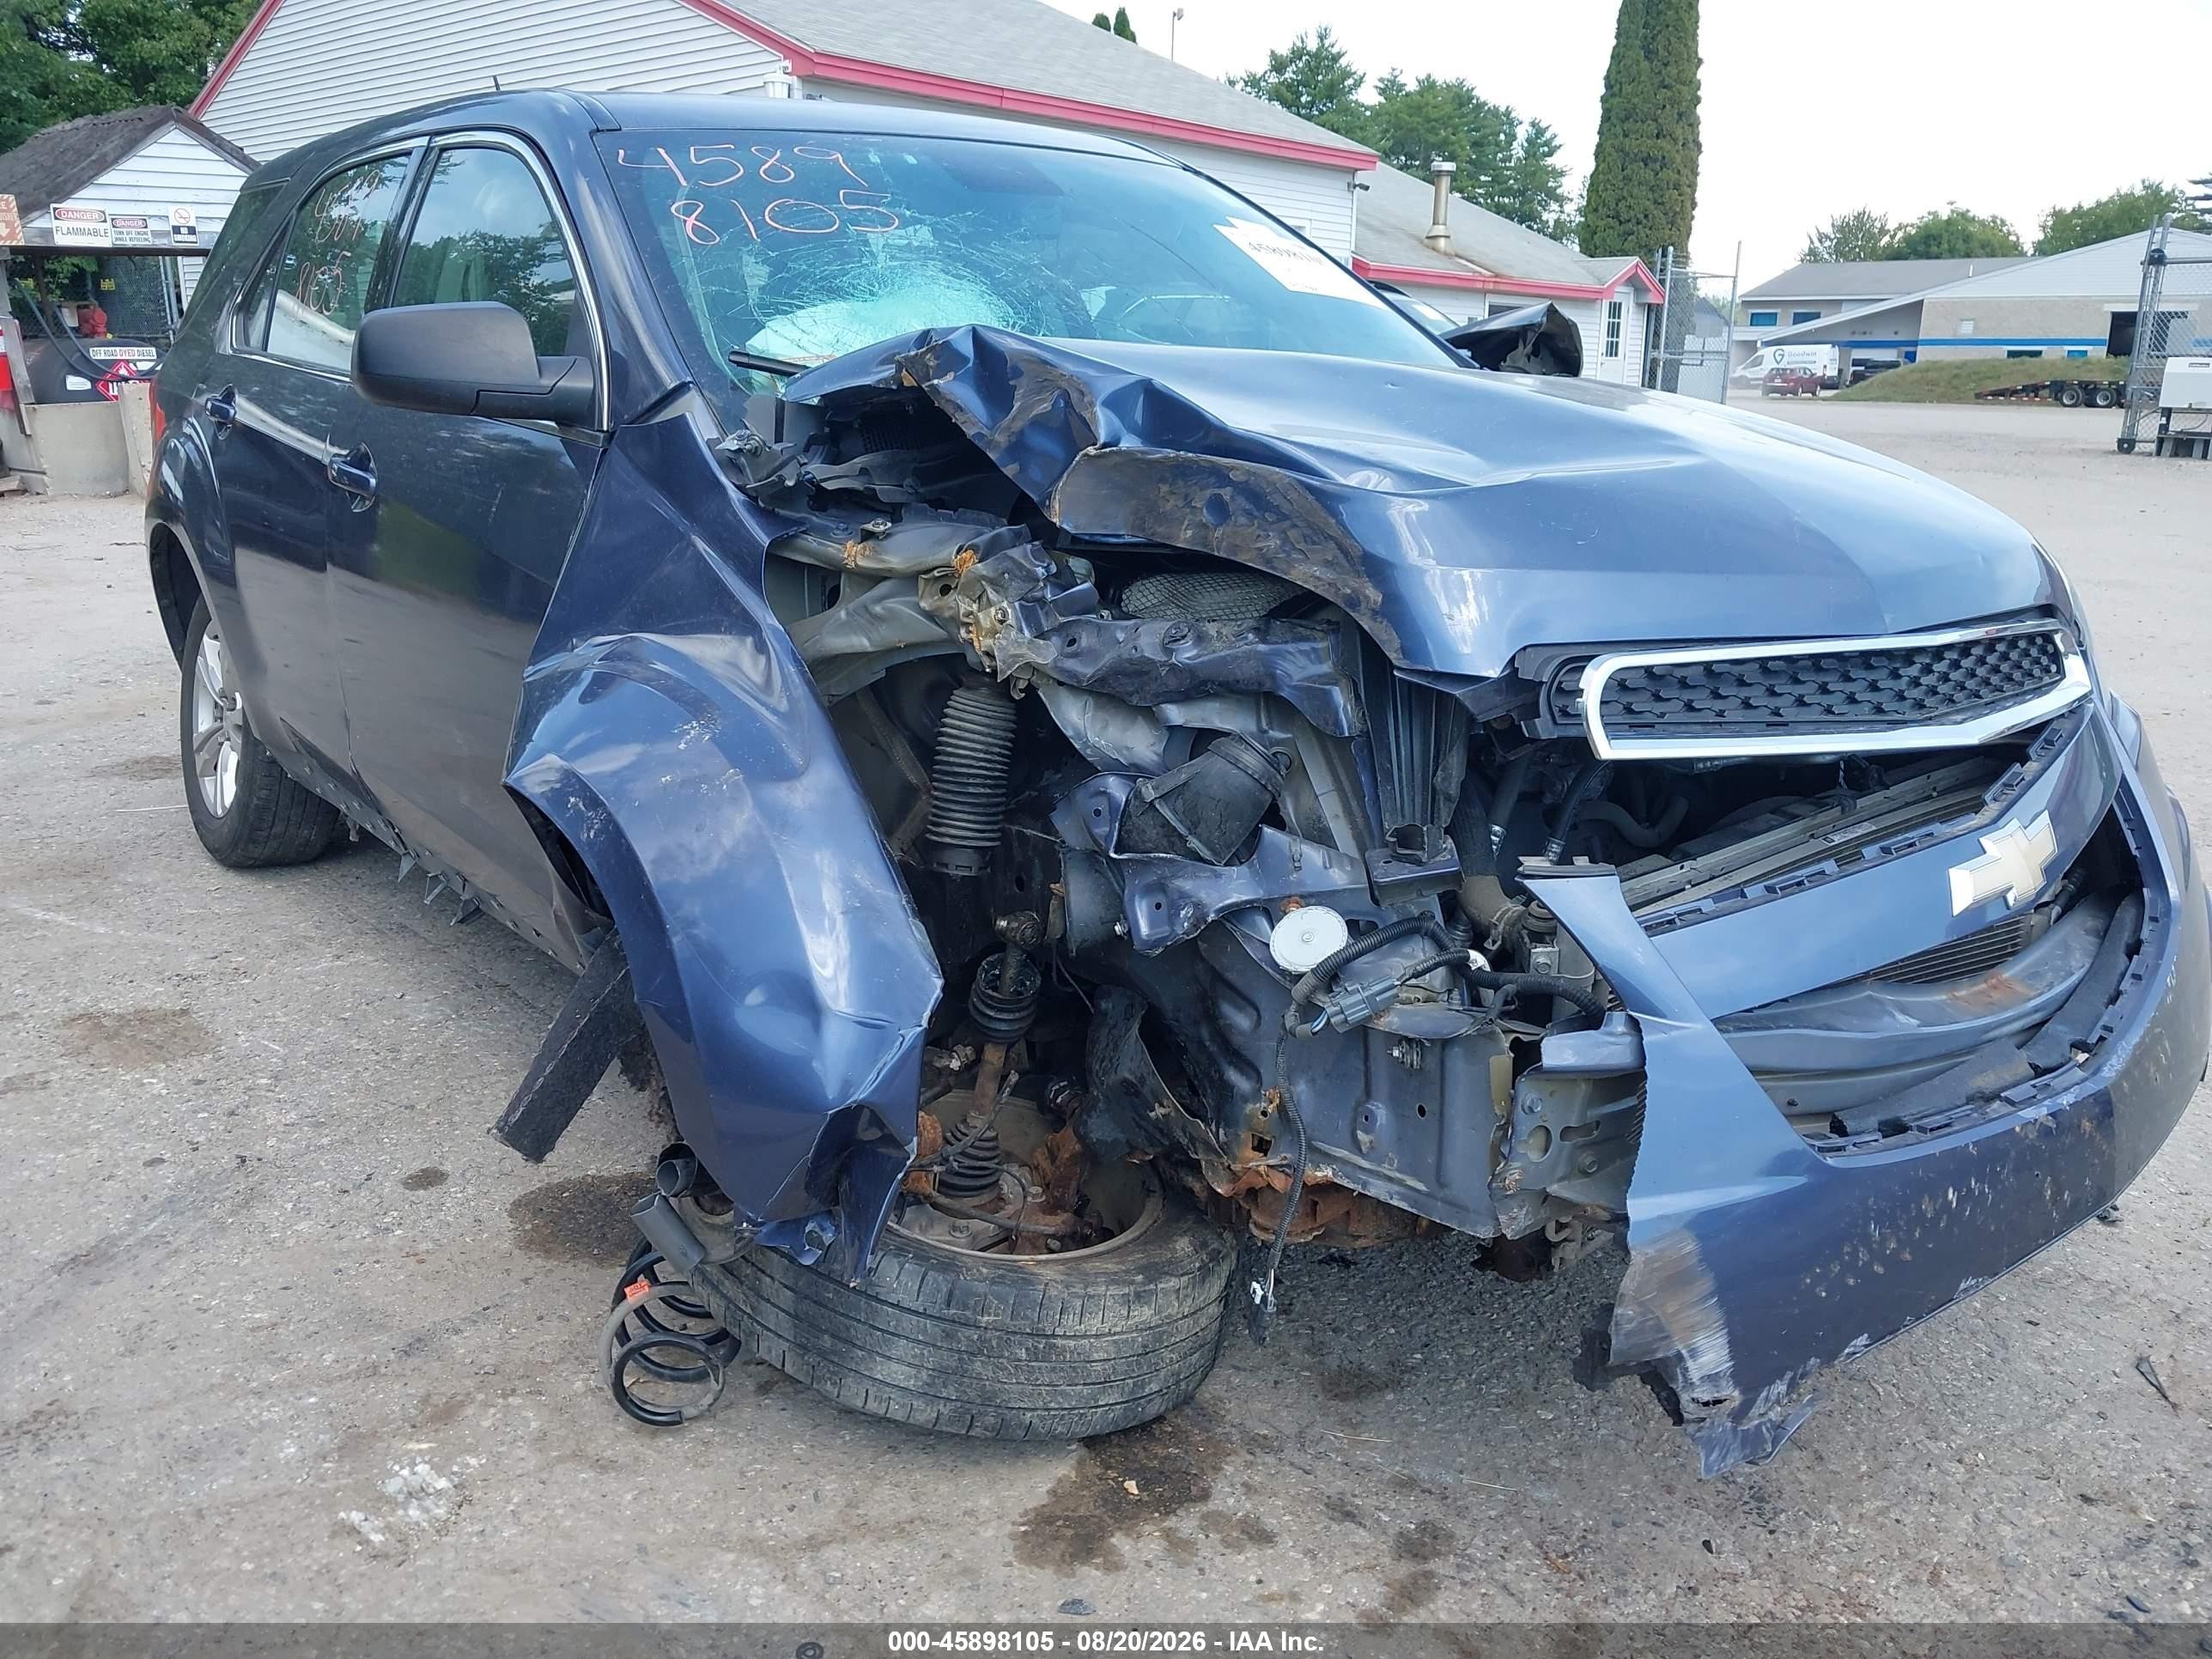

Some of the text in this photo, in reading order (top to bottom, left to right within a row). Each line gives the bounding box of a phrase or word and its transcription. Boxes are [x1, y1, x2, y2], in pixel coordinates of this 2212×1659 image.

[618, 144, 869, 187] 4589
[60, 210, 99, 220] DANGER
[670, 188, 900, 246] 8105
[116, 219, 143, 228] DANGER
[55, 226, 110, 238] FLAMMABLE
[92, 349, 155, 357] OFF ROAD DYED DIESEL
